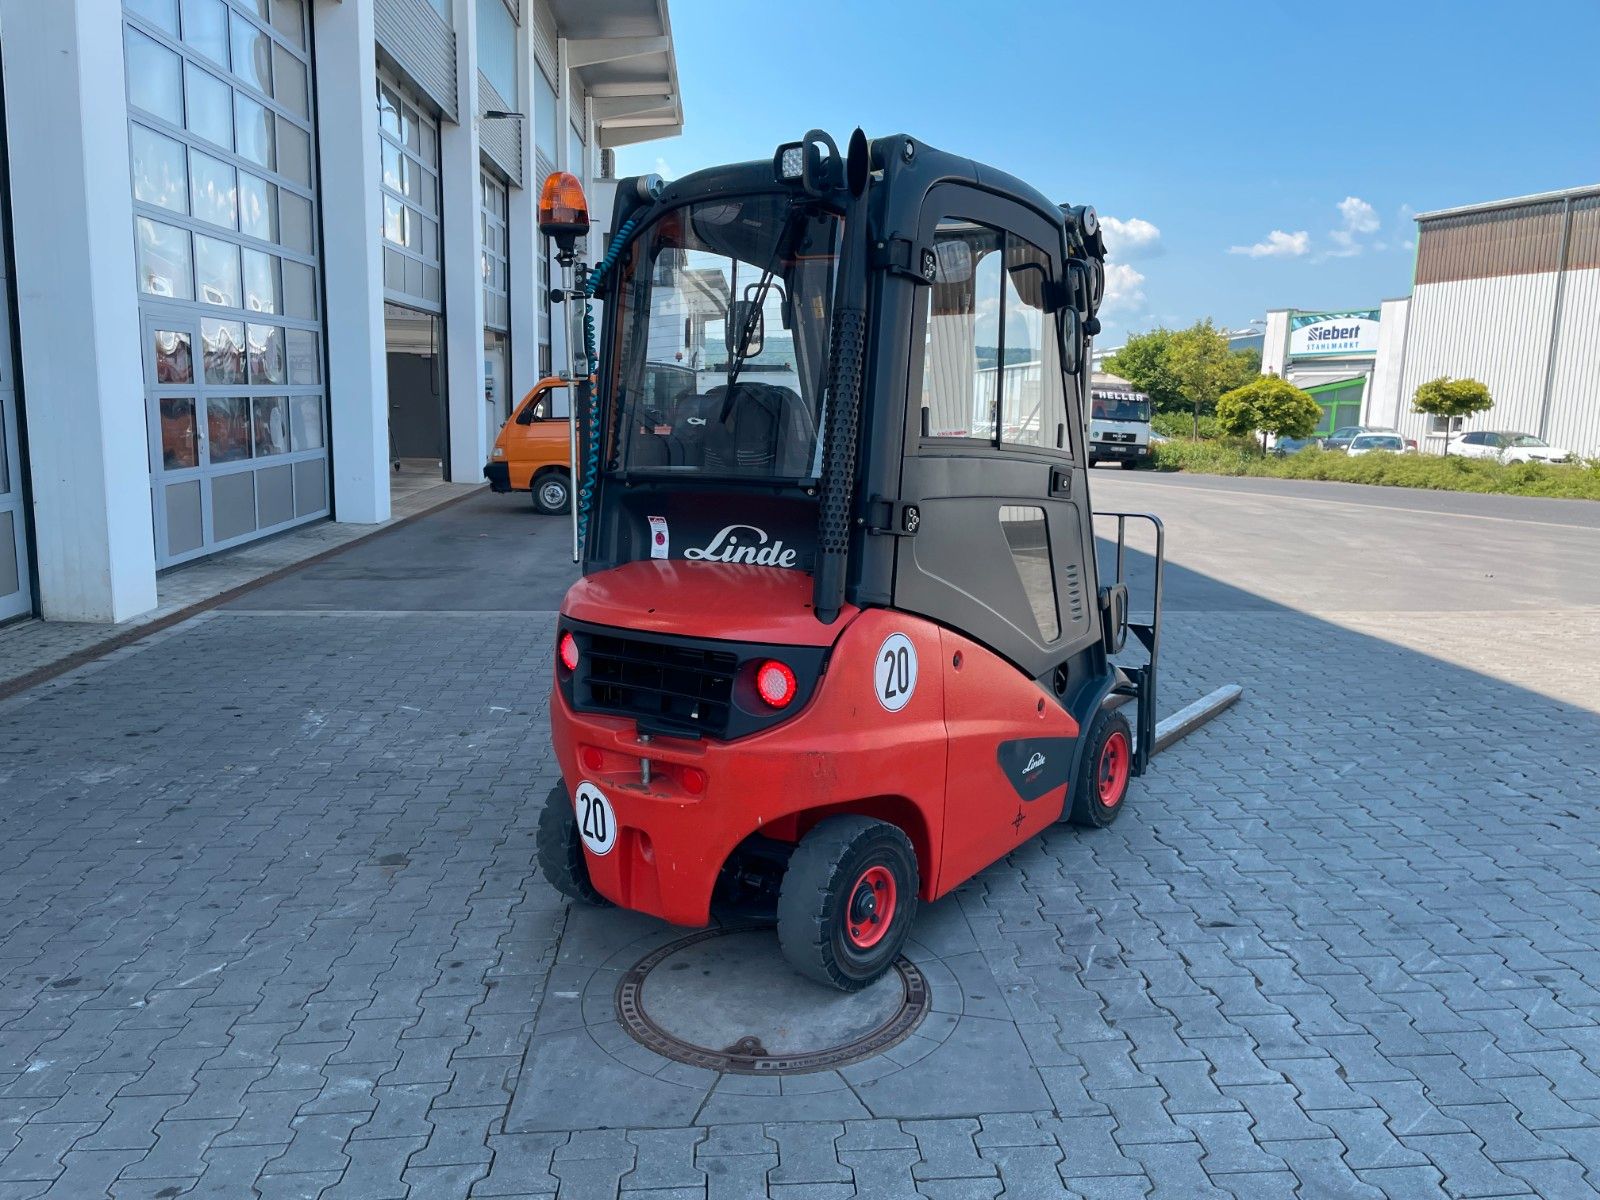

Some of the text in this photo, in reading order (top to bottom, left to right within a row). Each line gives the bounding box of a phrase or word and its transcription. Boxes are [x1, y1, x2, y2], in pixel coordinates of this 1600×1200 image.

[1307, 342, 1359, 351] STAHLMARKT
[1099, 391, 1144, 402] HELLER
[683, 525, 797, 568] Linde
[883, 646, 909, 699] 20
[580, 792, 607, 843] 20
